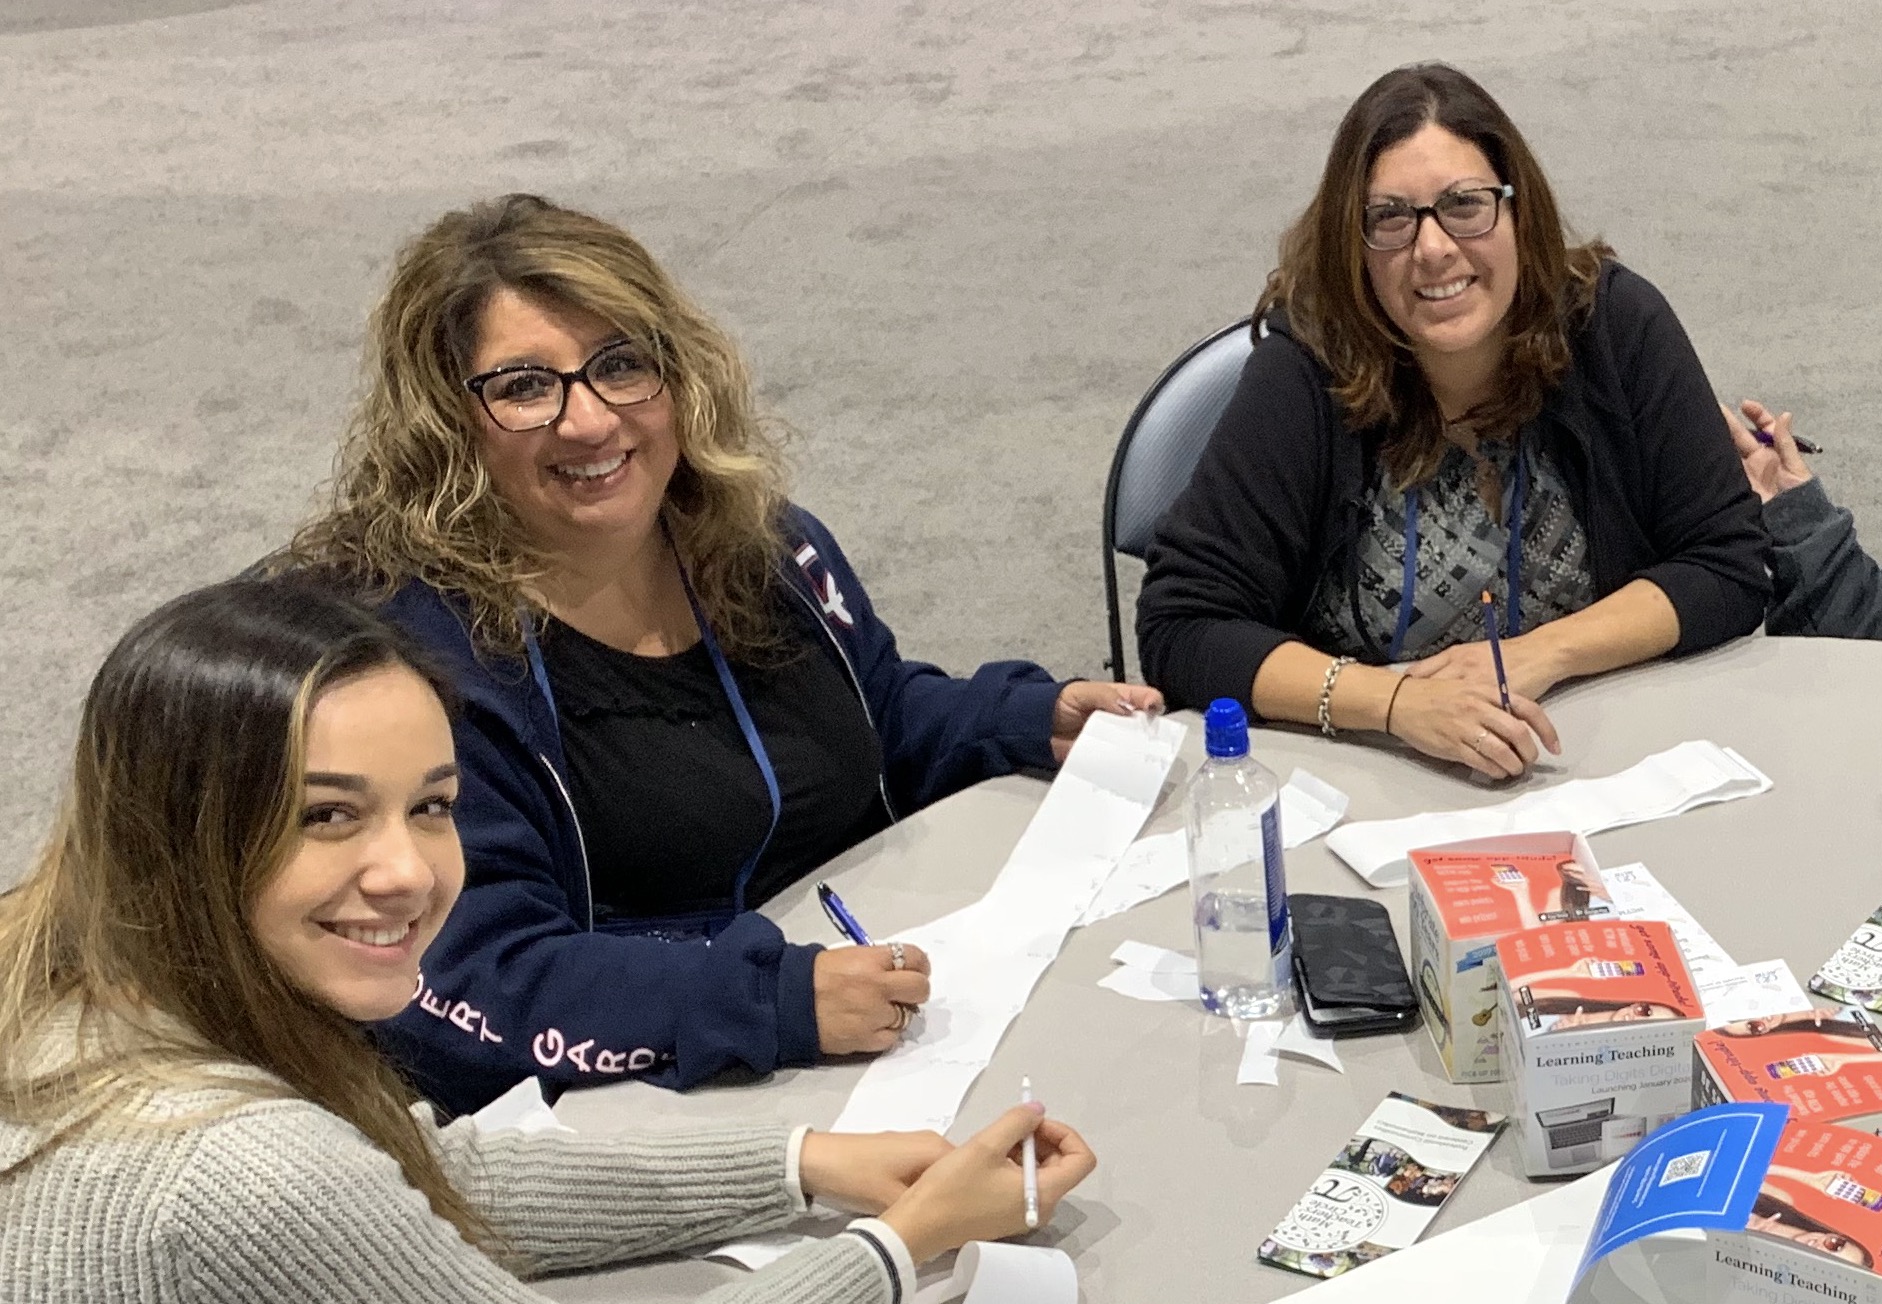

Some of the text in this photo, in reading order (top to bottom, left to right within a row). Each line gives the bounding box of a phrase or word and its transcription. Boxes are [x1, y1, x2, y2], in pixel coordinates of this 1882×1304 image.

[1536, 1052, 1603, 1068] Learning
[1608, 1044, 1675, 1062] Teaching
[1552, 1072, 1600, 1087] Taking
[1604, 1066, 1646, 1082] Digits
[1591, 1083, 1637, 1095] Launching
[1639, 1079, 1672, 1089] January
[1715, 1250, 1784, 1285] Learning
[1731, 1276, 1779, 1304] Taking
